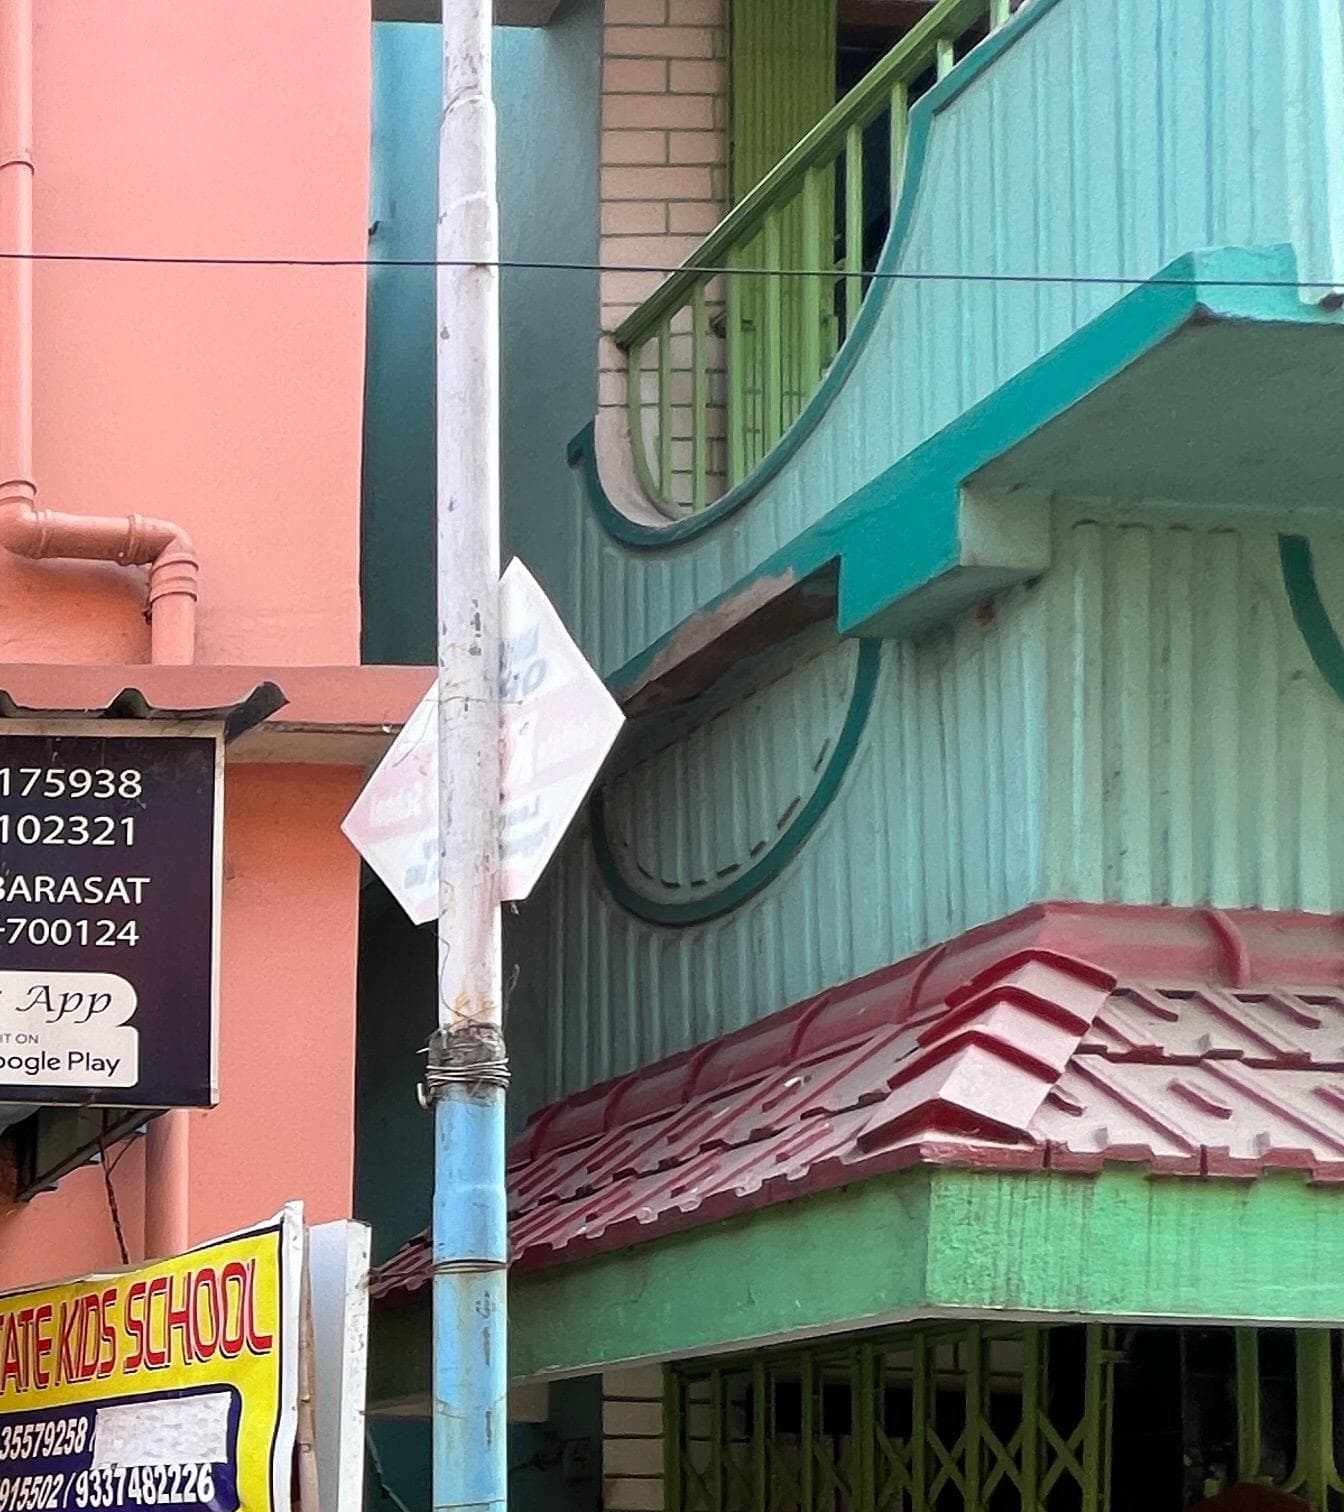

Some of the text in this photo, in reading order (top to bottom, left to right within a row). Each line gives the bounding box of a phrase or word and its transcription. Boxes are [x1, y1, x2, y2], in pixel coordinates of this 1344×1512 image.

[14, 983, 113, 1020] App
[66, 1050, 120, 1077] Play
[54, 1286, 118, 1386] KIDS
[123, 1258, 274, 1374] SCHOOL
[75, 1463, 215, 1508] 9337482226
